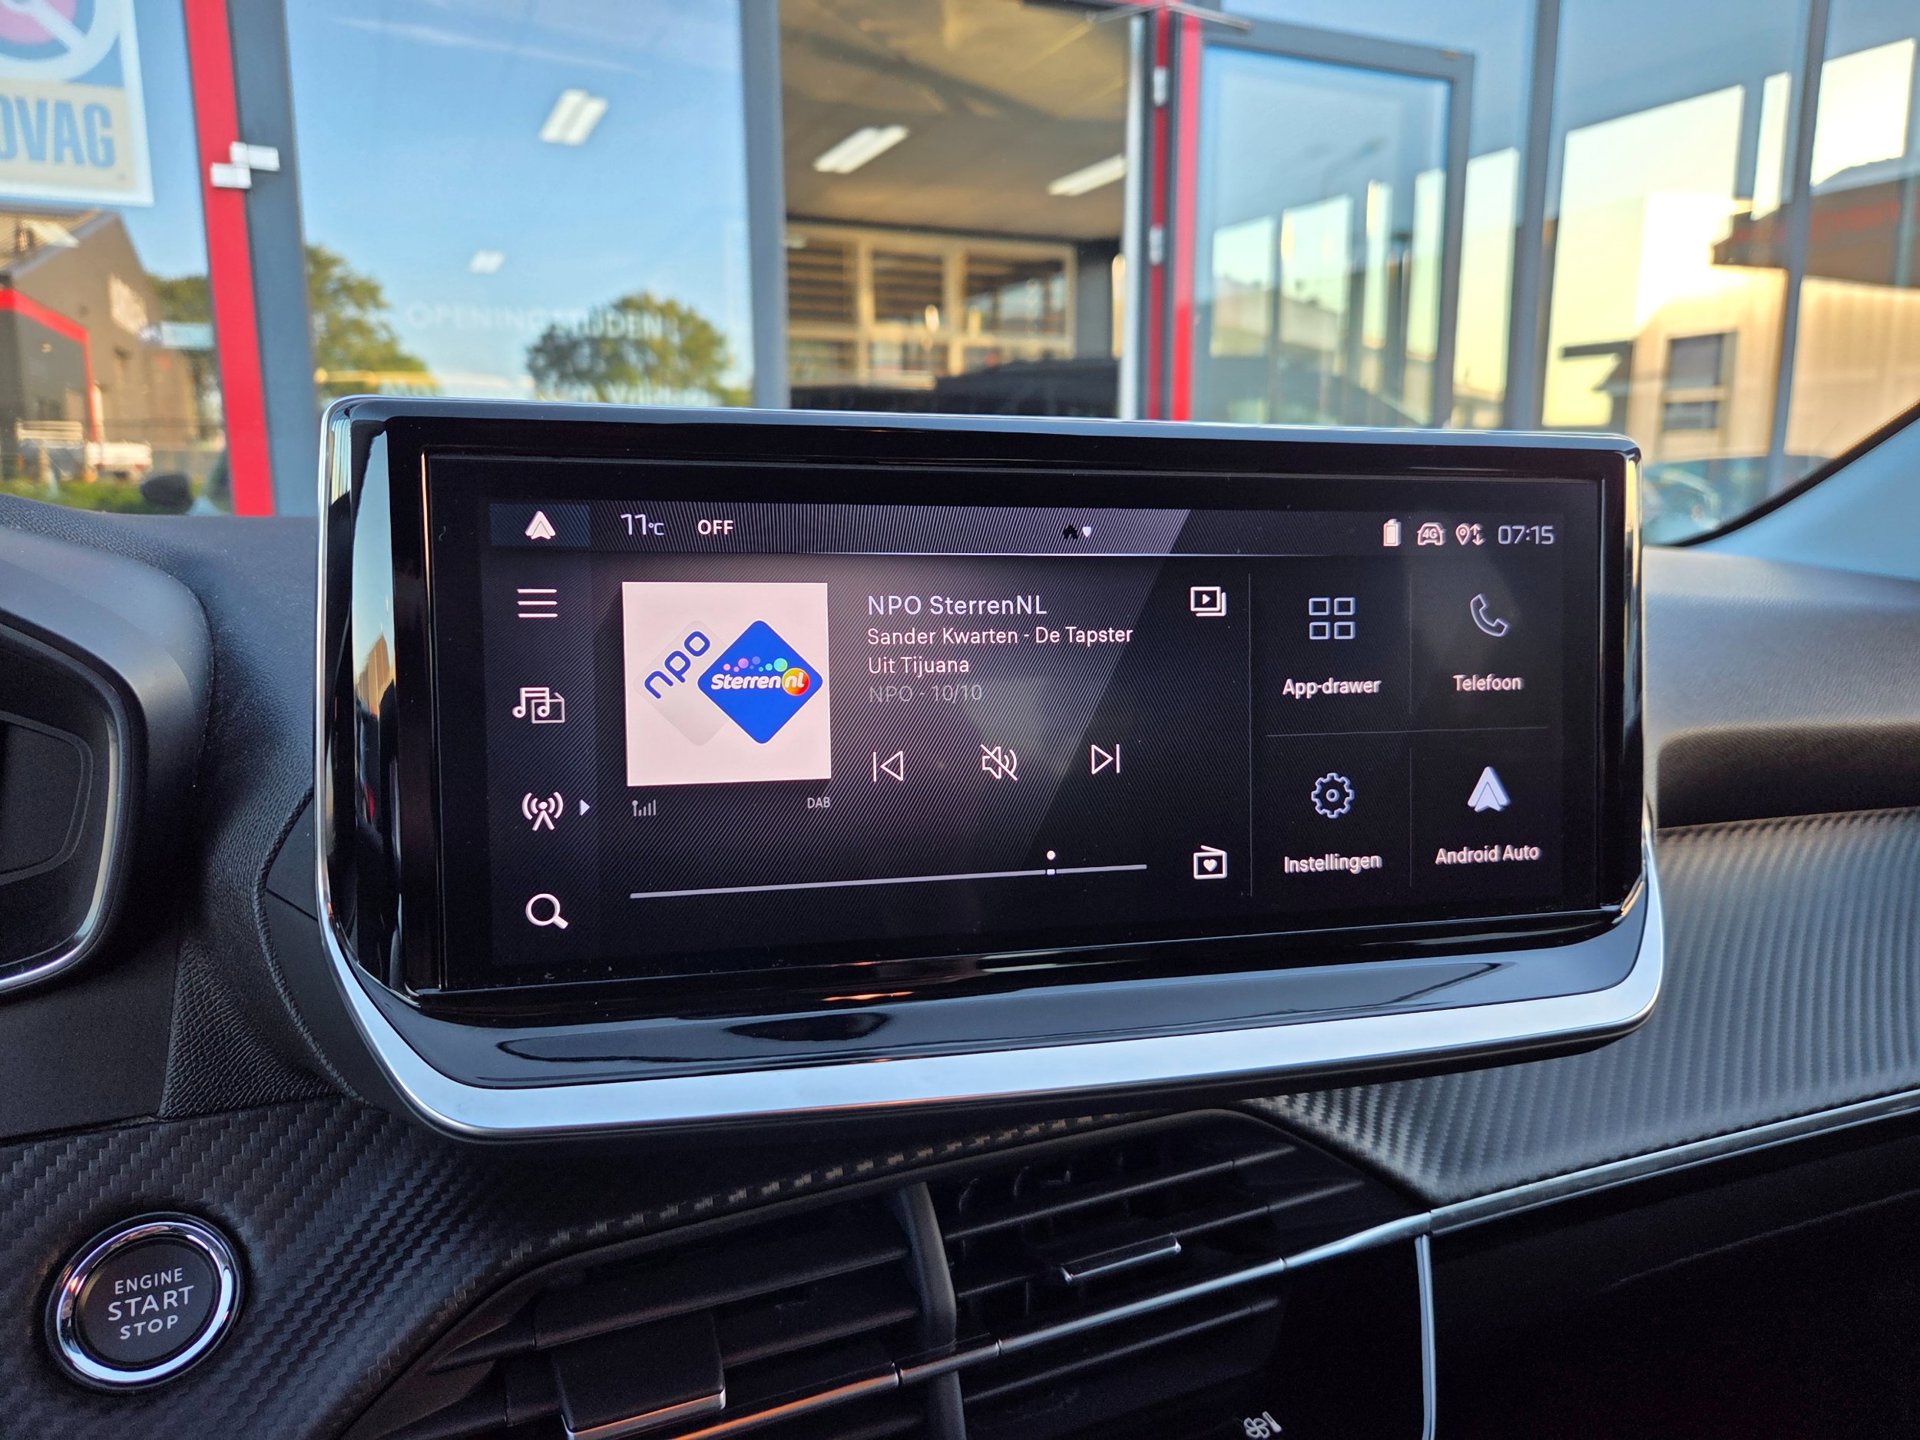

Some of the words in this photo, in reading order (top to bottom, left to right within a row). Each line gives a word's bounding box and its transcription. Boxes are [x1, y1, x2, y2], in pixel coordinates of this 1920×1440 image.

[697, 519, 735, 535] OFF
[1497, 524, 1555, 545] 07:15
[868, 595, 922, 615] NPO
[930, 595, 1048, 616] SterrenNL
[867, 627, 936, 645] Sander
[943, 627, 1018, 644] Kwarten
[1035, 627, 1060, 643] De
[1065, 626, 1134, 647] Tapster
[644, 631, 711, 699] npo
[868, 657, 896, 674] Uit
[901, 656, 970, 678] Tijuana
[1282, 677, 1382, 699] App-drawer
[1453, 674, 1523, 692] Telefoon
[869, 685, 914, 703] NPO
[932, 684, 983, 704] 10/10
[807, 796, 831, 809] DAB
[1284, 853, 1383, 875] Instellingen
[1435, 845, 1500, 865] Android
[1502, 844, 1541, 862] Auto
[114, 1267, 183, 1295] ENGINE
[108, 1285, 194, 1321] START
[120, 1315, 178, 1340] STOP
